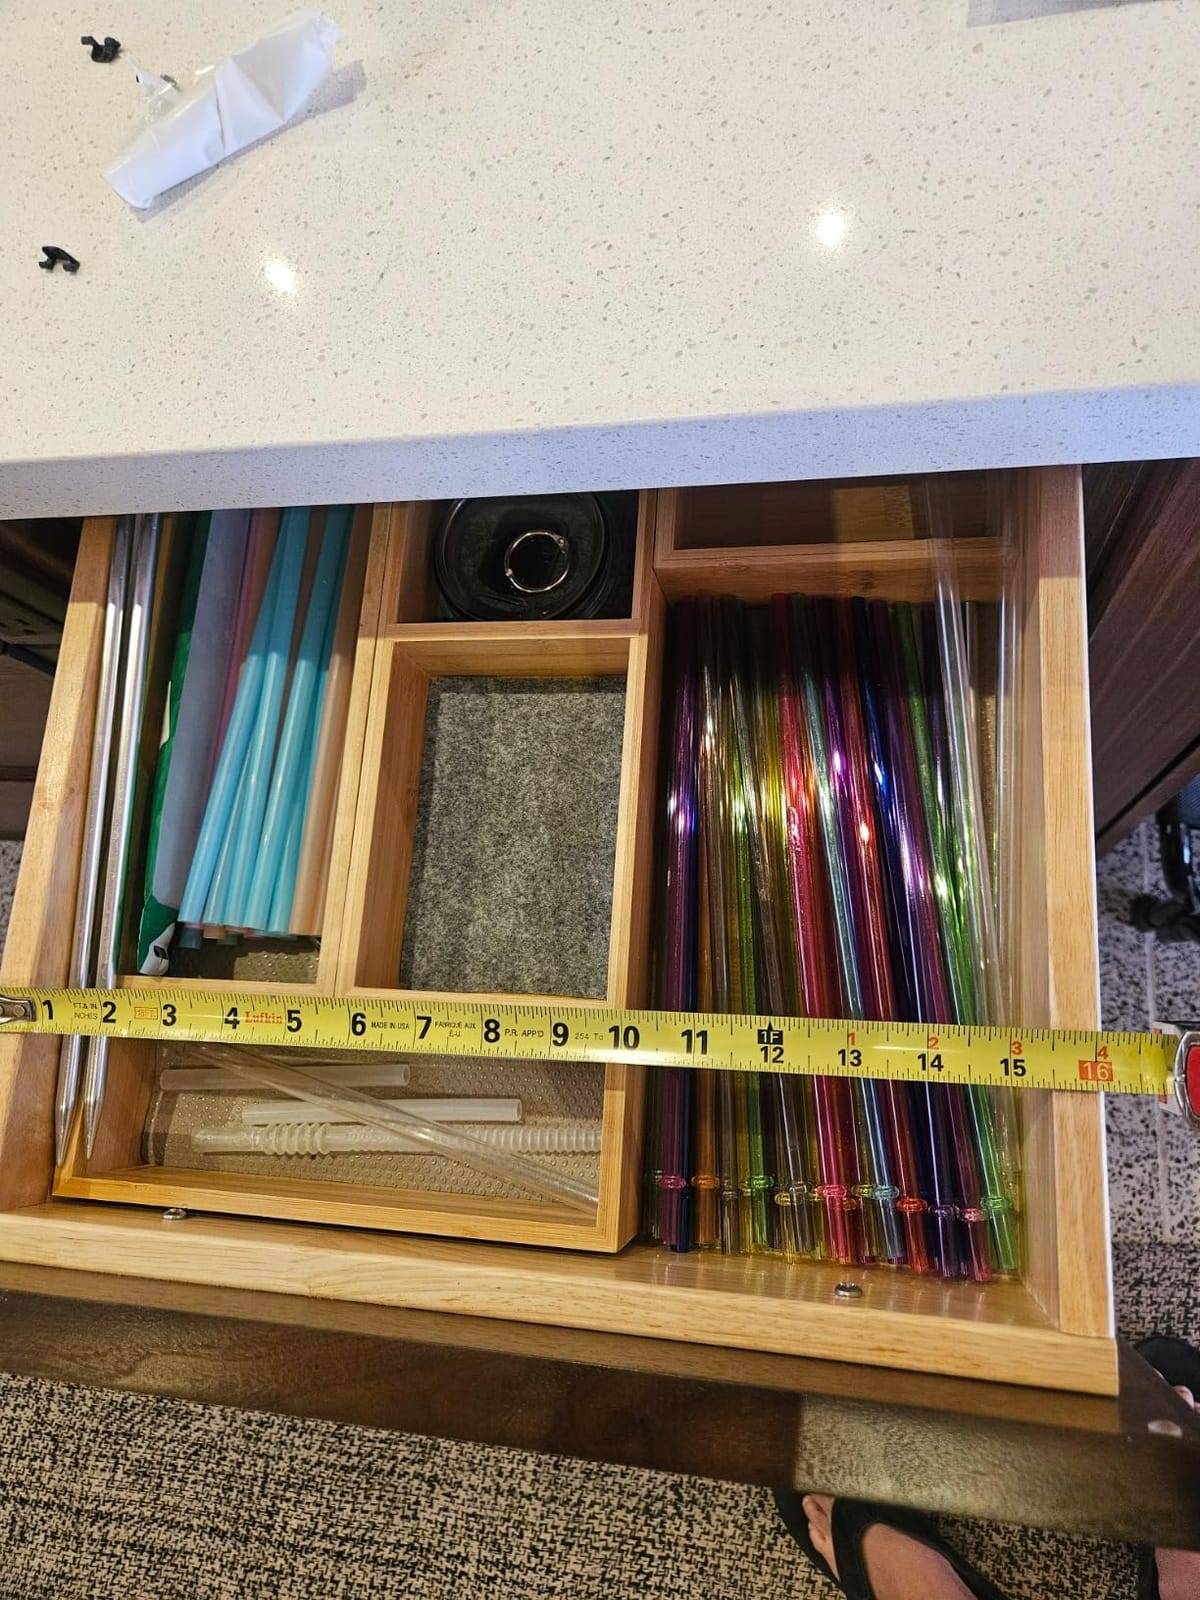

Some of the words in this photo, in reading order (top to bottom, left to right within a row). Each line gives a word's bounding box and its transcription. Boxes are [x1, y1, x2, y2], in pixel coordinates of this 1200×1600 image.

[42, 1000, 54, 1020] 1
[102, 1001, 117, 1023] 2
[162, 1004, 177, 1027] 3
[224, 1007, 240, 1030] 4
[244, 1011, 283, 1024] Lufkin
[287, 1009, 302, 1032] 5
[351, 1012, 366, 1036] 6
[370, 1021, 388, 1029] MADE
[397, 1022, 410, 1030] USA
[416, 1015, 432, 1039] 7
[484, 1018, 500, 1043] 8
[552, 1022, 569, 1047] 9
[608, 1025, 640, 1050] 10
[760, 1030, 781, 1045] 1F
[847, 1032, 856, 1046] 1
[681, 1029, 708, 1055] 11
[928, 1036, 940, 1050] 2
[1011, 1041, 1023, 1056] 3
[760, 1046, 784, 1064] 12
[837, 1049, 862, 1067] 13
[1097, 1045, 1109, 1060] 4
[917, 1053, 944, 1072] 14
[1000, 1058, 1027, 1077] 15
[1081, 1062, 1110, 1080] 16
